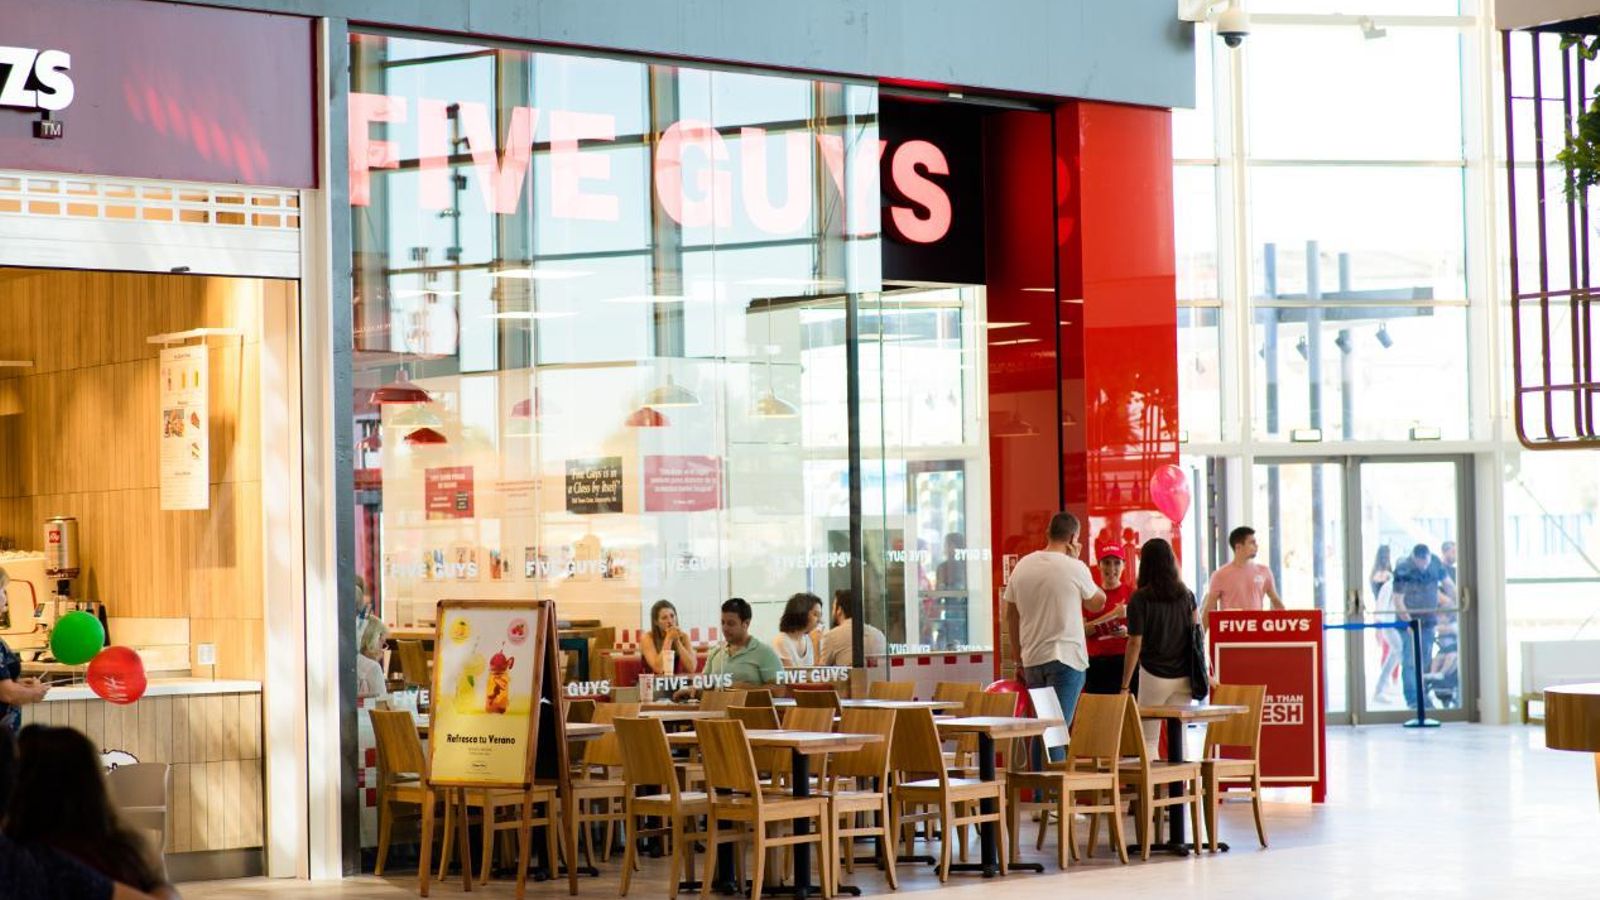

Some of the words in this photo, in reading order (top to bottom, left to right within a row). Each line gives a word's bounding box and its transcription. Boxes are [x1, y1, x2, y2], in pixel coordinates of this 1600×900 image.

[42, 122, 61, 136] TM
[348, 92, 619, 221] FIVE
[655, 118, 952, 243] GUYS
[1219, 619, 1257, 632] FIVE
[1262, 618, 1310, 632] GUYS
[655, 675, 688, 692] FIVE
[692, 673, 733, 689] GUYS
[776, 670, 807, 684] FIVE
[811, 667, 848, 683] GUYS
[567, 680, 610, 697] GUYS
[1276, 695, 1303, 704] THAN
[488, 735, 516, 745] Verano
